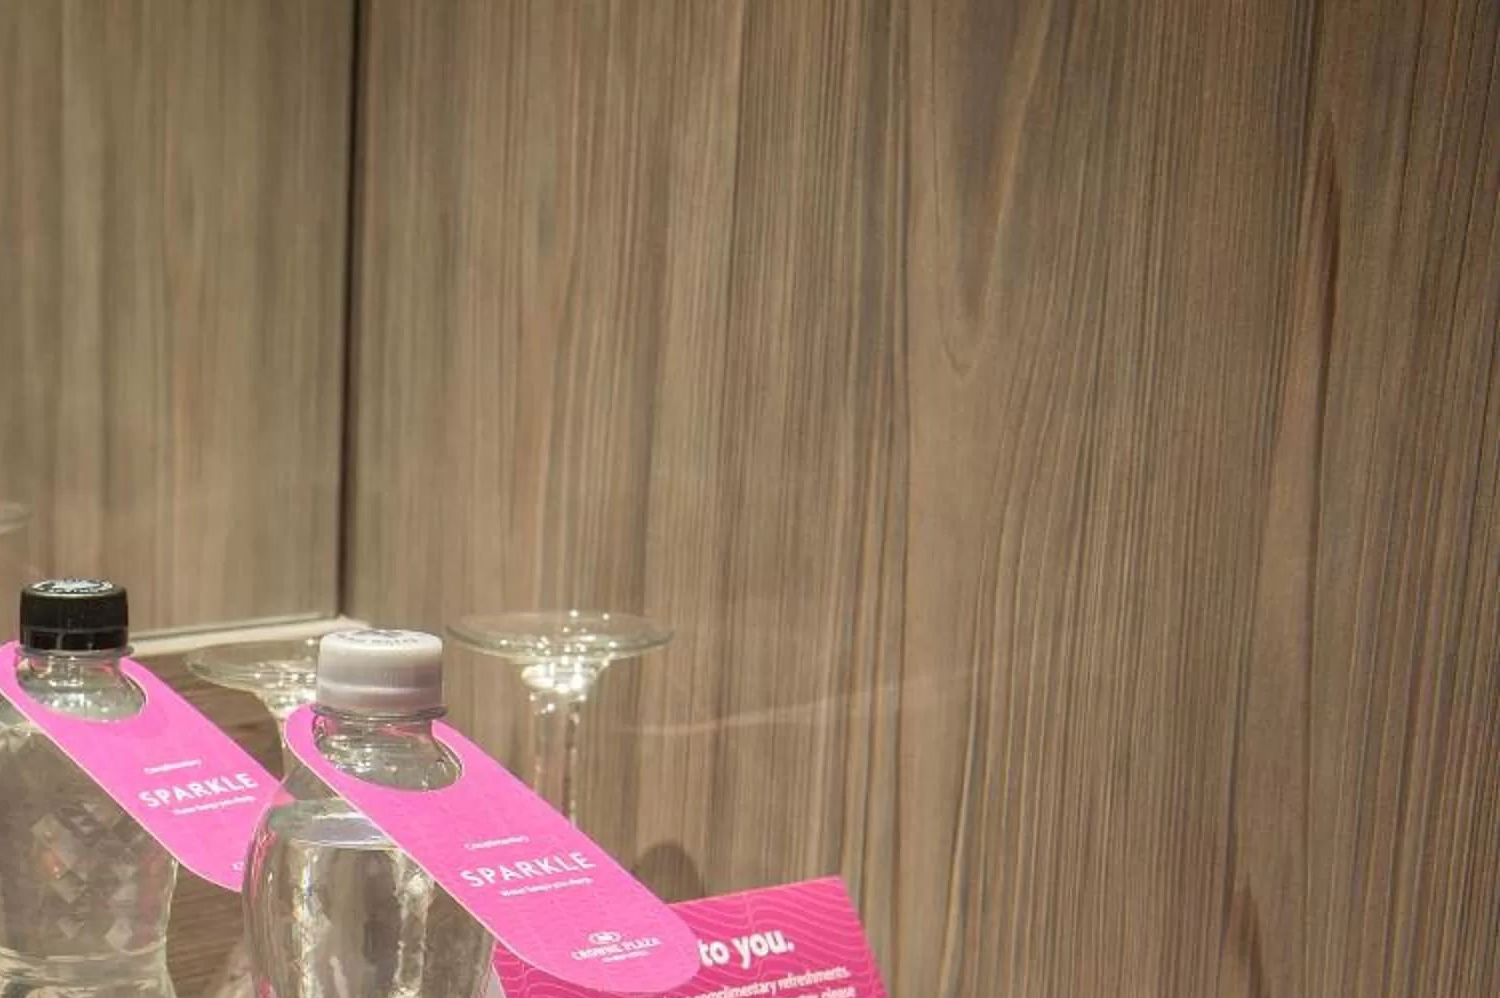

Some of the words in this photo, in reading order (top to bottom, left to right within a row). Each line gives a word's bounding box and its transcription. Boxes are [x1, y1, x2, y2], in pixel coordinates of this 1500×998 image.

[138, 772, 260, 807] SPARKLE
[460, 852, 596, 888] SPARKLE
[697, 939, 730, 967] to
[731, 930, 795, 969] you.
